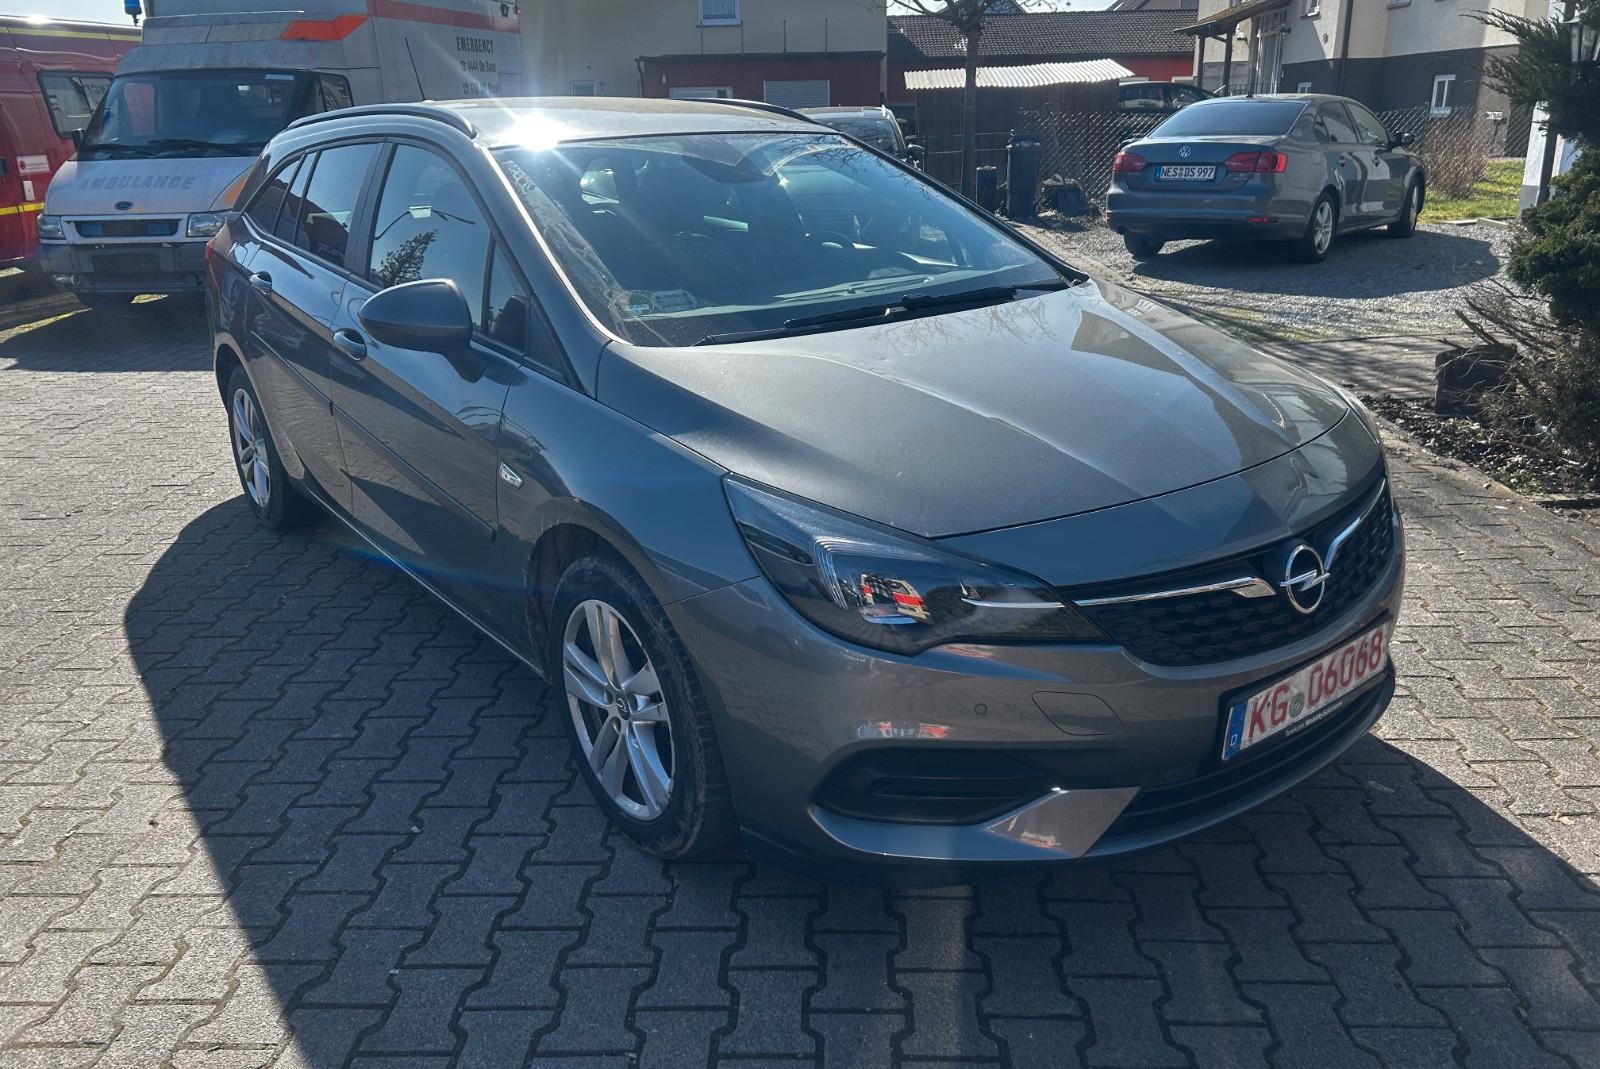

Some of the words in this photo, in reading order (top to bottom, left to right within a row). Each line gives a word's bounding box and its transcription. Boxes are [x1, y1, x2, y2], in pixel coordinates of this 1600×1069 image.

[456, 36, 494, 54] EMERGENCY
[1161, 167, 1178, 177] NES
[1183, 167, 1196, 177] DS
[1196, 167, 1214, 178] 997
[79, 175, 196, 191] AMBULANCE
[1247, 683, 1291, 740] KG
[1307, 629, 1384, 708] 06068
[1230, 734, 1237, 747] D
